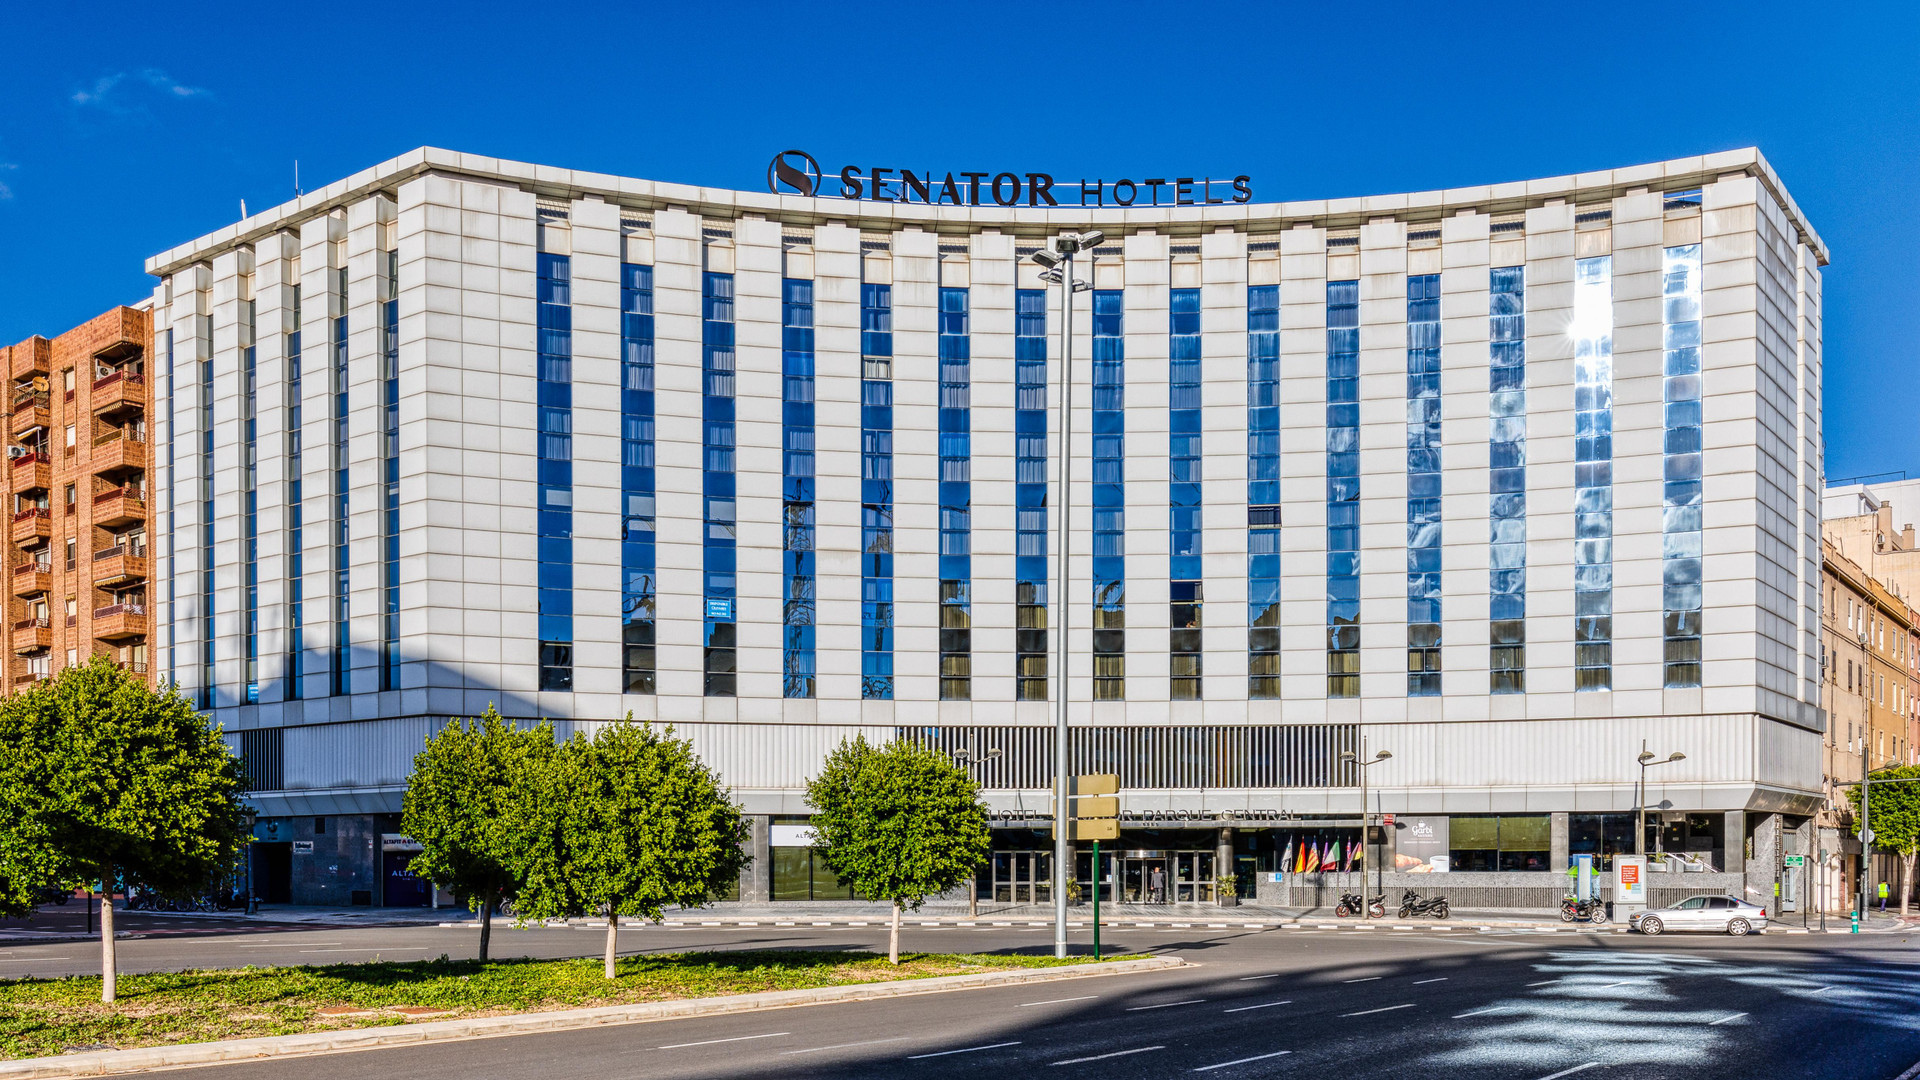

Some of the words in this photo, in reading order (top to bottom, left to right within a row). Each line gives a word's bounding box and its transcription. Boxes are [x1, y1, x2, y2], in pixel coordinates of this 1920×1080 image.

[840, 165, 1058, 206] SENATOR
[1081, 175, 1252, 206] HOTELS
[988, 809, 1044, 821] HOTEL
[1143, 809, 1212, 821] PARQUE
[1221, 809, 1302, 821] CENTRAL
